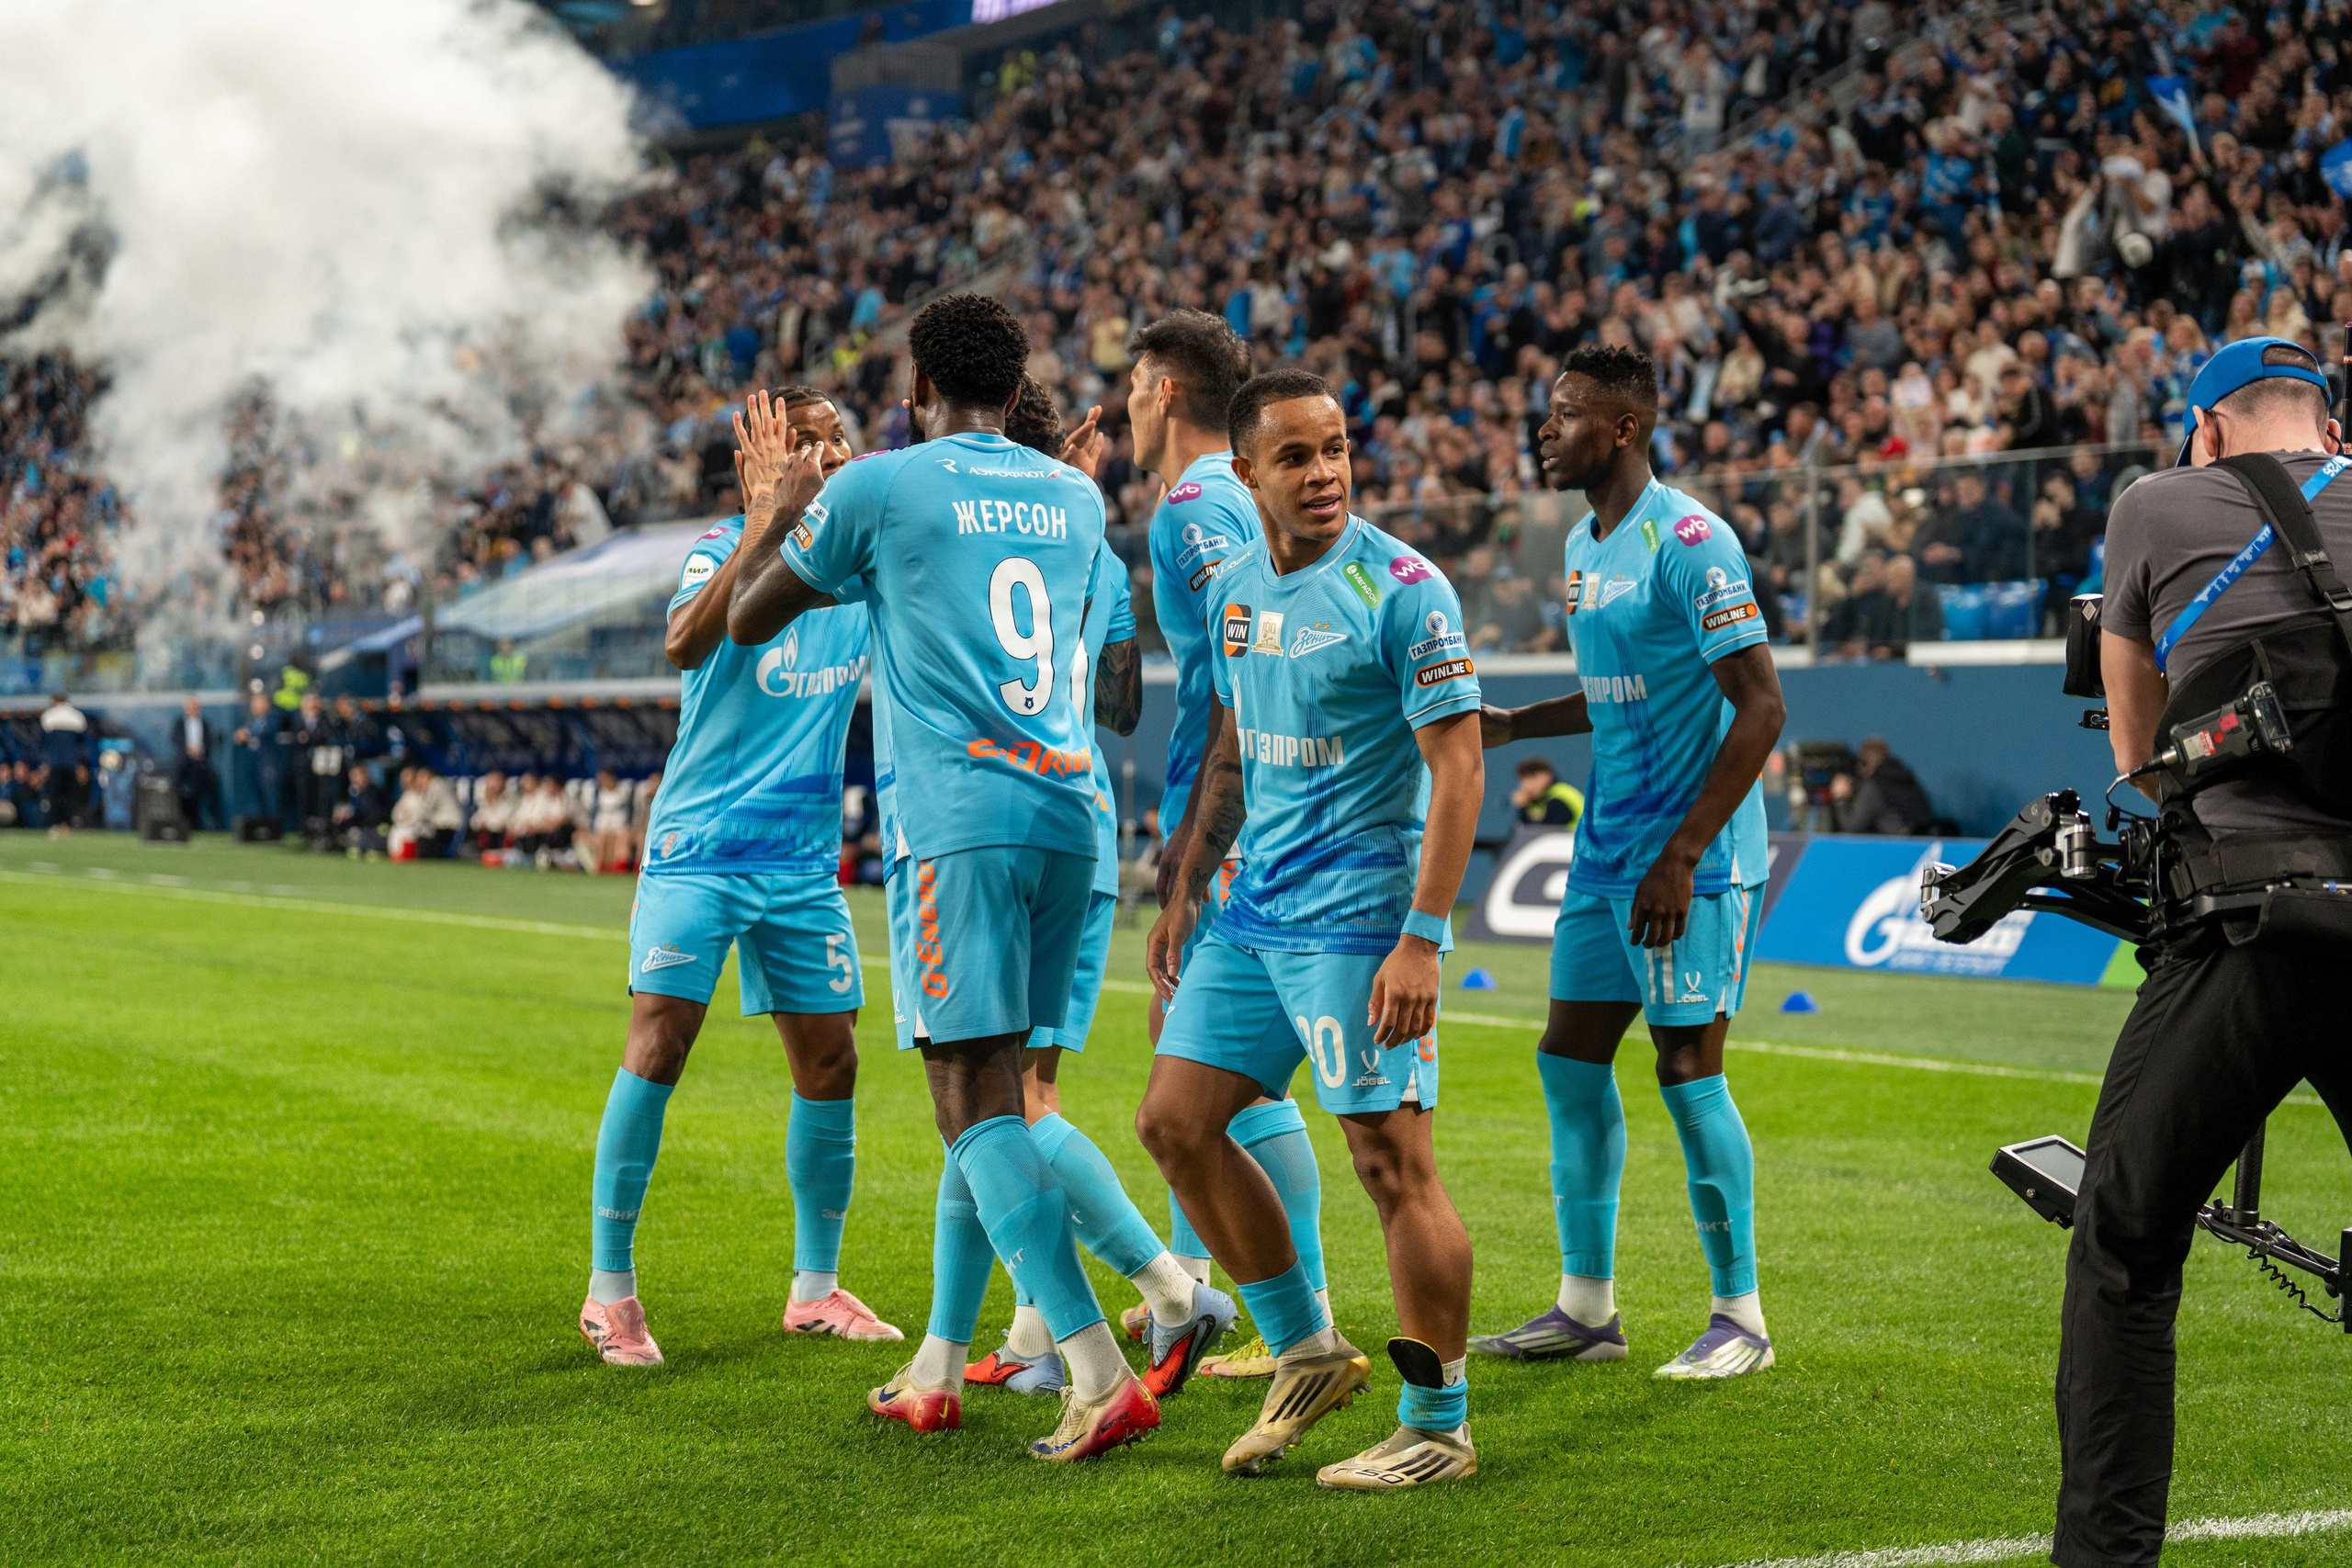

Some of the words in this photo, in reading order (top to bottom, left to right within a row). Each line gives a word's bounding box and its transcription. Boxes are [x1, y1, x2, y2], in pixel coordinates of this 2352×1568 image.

[969, 467, 1045, 479] АЭРОФЛОТ
[952, 500, 1067, 540] ЖЕРСОН
[1678, 518, 1708, 538] wb
[1178, 536, 1226, 567] ГАЗПРОМБАНК
[1191, 564, 1219, 590] WINLIN
[1353, 572, 1378, 604] МЕГАФОН
[1696, 582, 1747, 607] ГАЗПРОМБАНК
[1706, 607, 1747, 628] WINLINE
[989, 557, 1055, 716] 9
[1227, 623, 1248, 639] WIN
[1411, 634, 1464, 659] ГАЗПРОМБАНК
[1421, 661, 1465, 683] WINLINE
[1246, 728, 1344, 767] ГЗПРОМ
[825, 933, 853, 993] 5
[1351, 1076, 1391, 1088] JÖGEL
